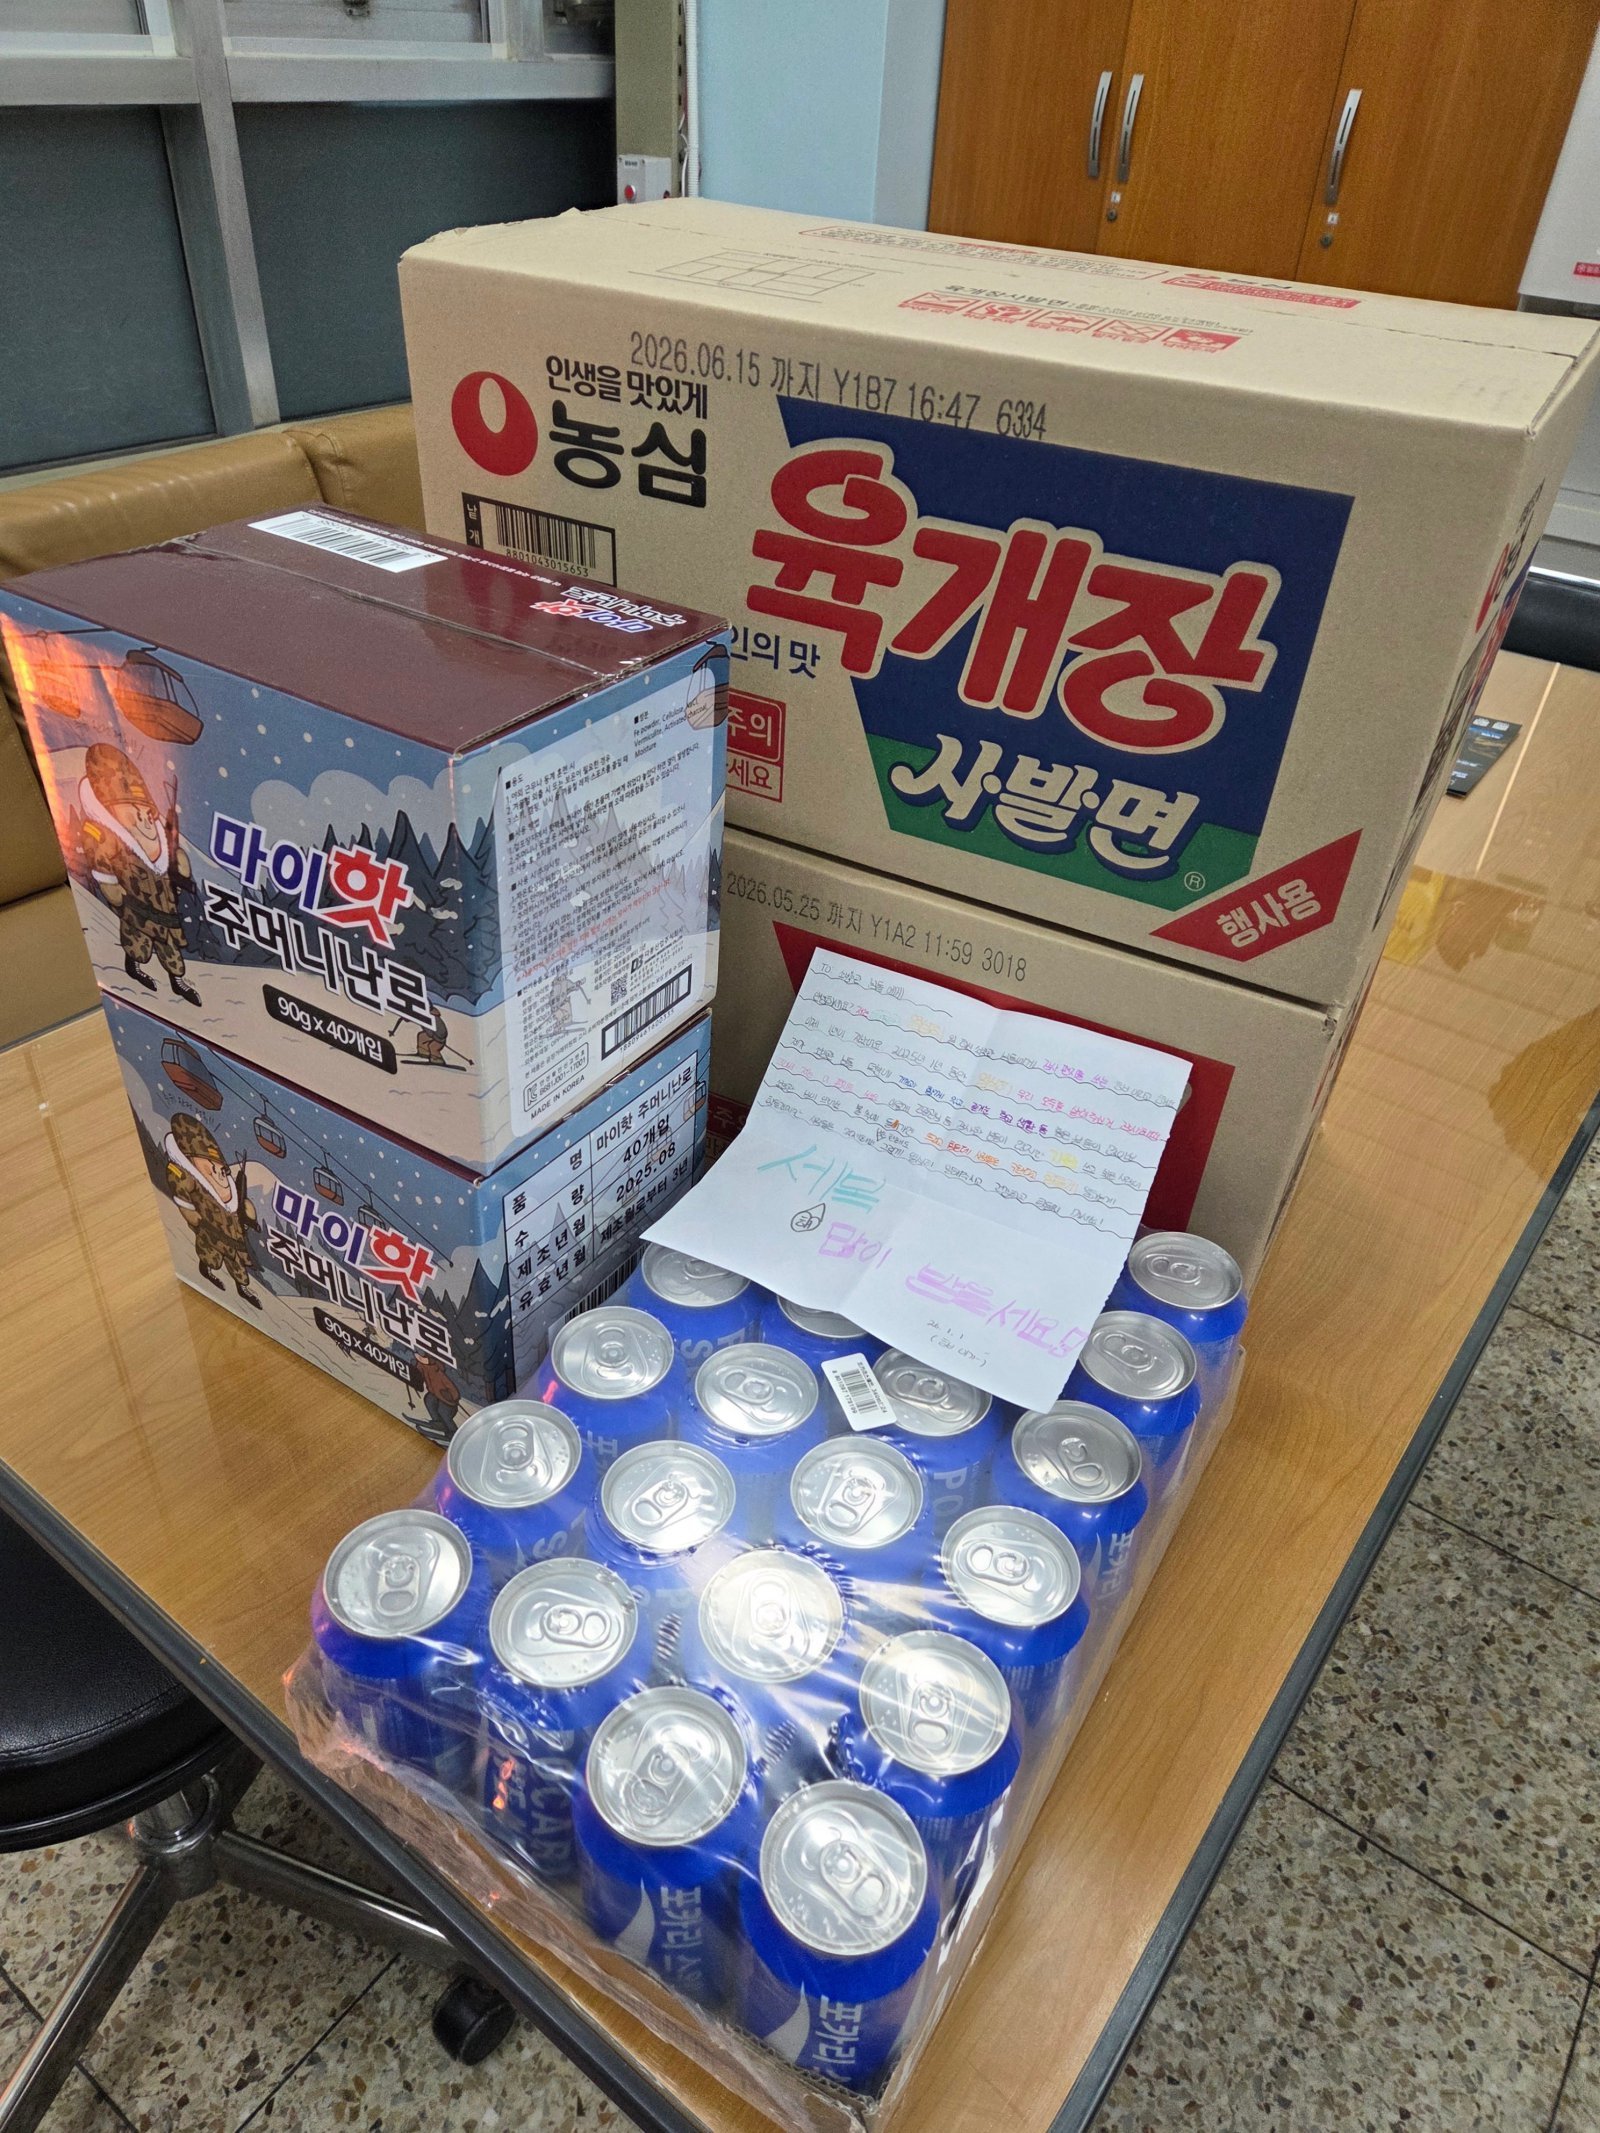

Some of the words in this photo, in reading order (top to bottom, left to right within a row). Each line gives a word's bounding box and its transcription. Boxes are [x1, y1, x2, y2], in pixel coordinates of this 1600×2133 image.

[546, 355, 622, 403] 인생을
[627, 372, 709, 420] 맛있게
[630, 331, 760, 387] 2026.06.15
[771, 356, 820, 399] 까지
[909, 386, 982, 429] 16:47
[996, 399, 1047, 441] 6334
[549, 399, 708, 509] 농심
[506, 549, 589, 578] 8801043015653
[746, 447, 1273, 750] 육개장
[789, 640, 821, 679] 맛
[726, 761, 773, 789] 세요
[889, 733, 1201, 870] 사발면
[212, 813, 412, 949] 마이핫
[726, 871, 821, 923] 2026.05.25
[827, 898, 865, 935] 까지
[871, 909, 919, 949] Y1A2
[924, 925, 973, 966] 11:59
[982, 941, 1027, 982] 3018
[1215, 878, 1322, 948] 행사용
[204, 882, 437, 1031] 주머니난로
[530, 1101, 551, 1121] MADE
[552, 1094, 561, 1106] IN
[562, 1074, 586, 1097] KOREA
[596, 1113, 633, 1152] 마이핫
[637, 1066, 693, 1120] 주머니난로
[622, 1114, 671, 1164] 40개입
[271, 1182, 436, 1301] 마이핫
[600, 1175, 668, 1245] 제조월로부터
[671, 1159, 690, 1183] 3년
[266, 1231, 457, 1369] 주머니난로
